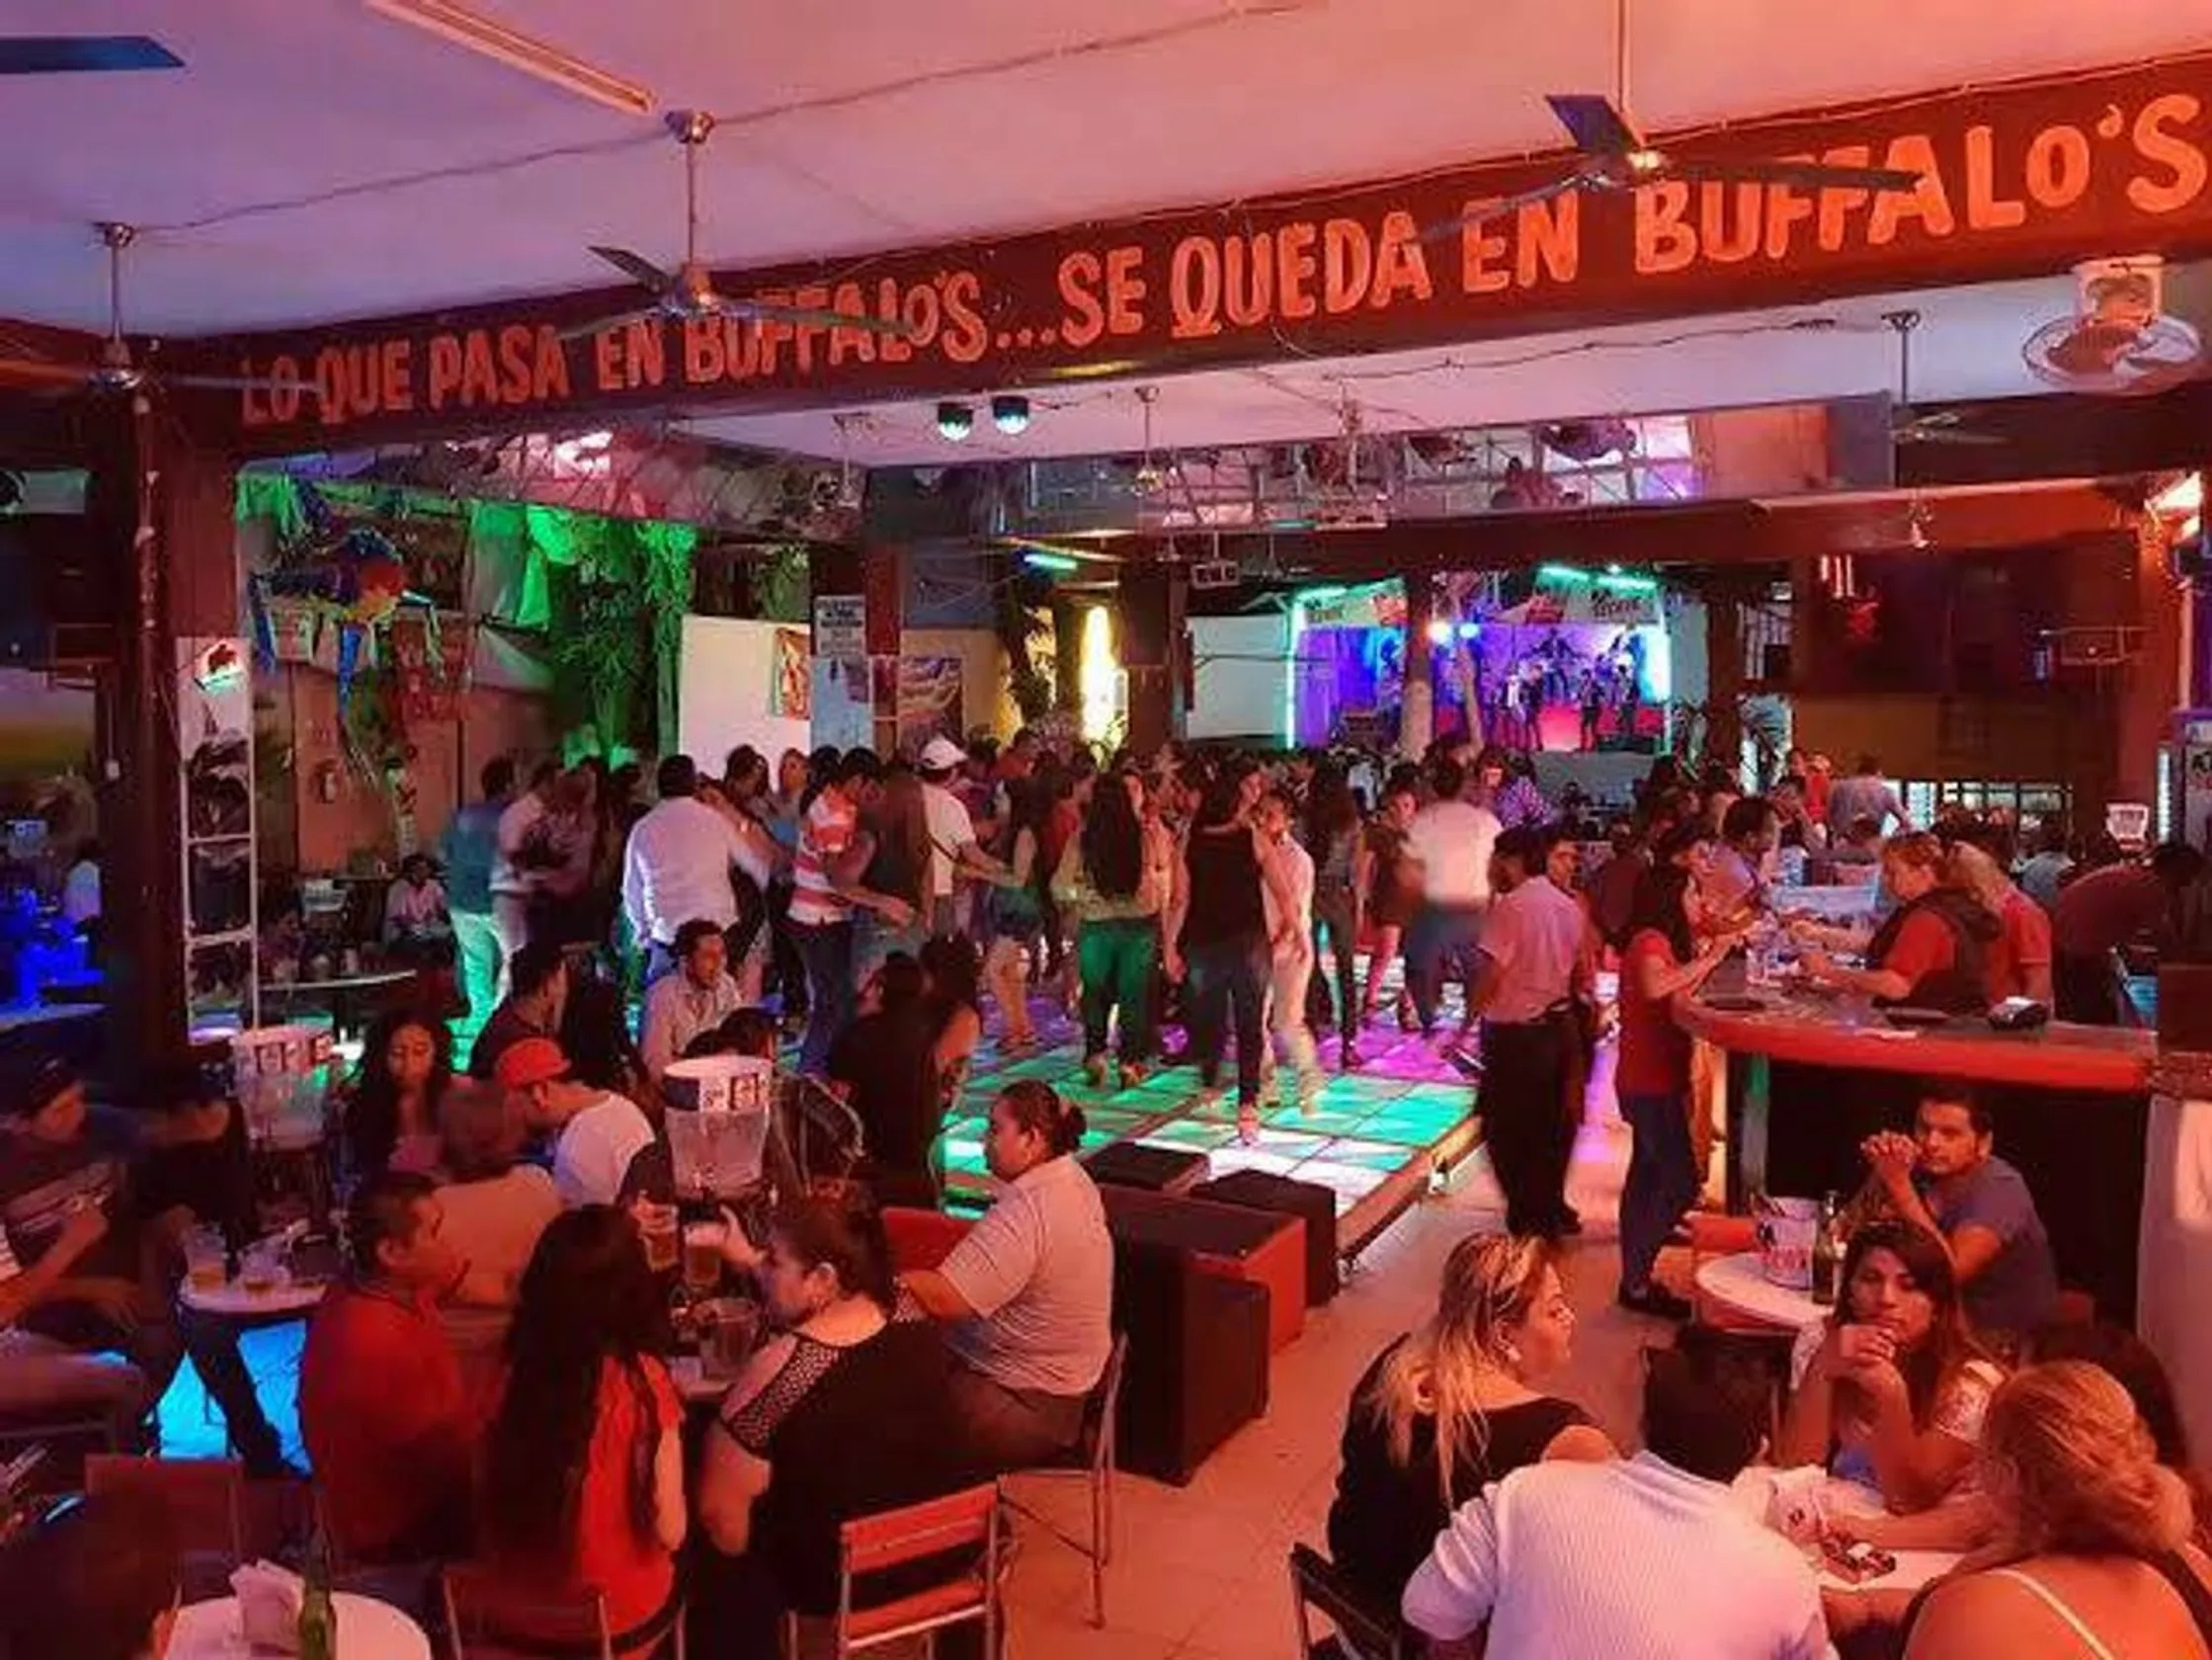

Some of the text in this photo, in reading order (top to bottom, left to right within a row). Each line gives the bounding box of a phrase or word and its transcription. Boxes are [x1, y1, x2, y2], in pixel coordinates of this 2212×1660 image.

[241, 355, 299, 425] LO
[315, 337, 414, 425] QUE
[429, 323, 571, 409] PASA
[597, 317, 665, 390] EN
[1169, 210, 1434, 340] QUEDA
[1461, 188, 1580, 293] EN
[1634, 94, 2208, 275] BUFFALO'S
